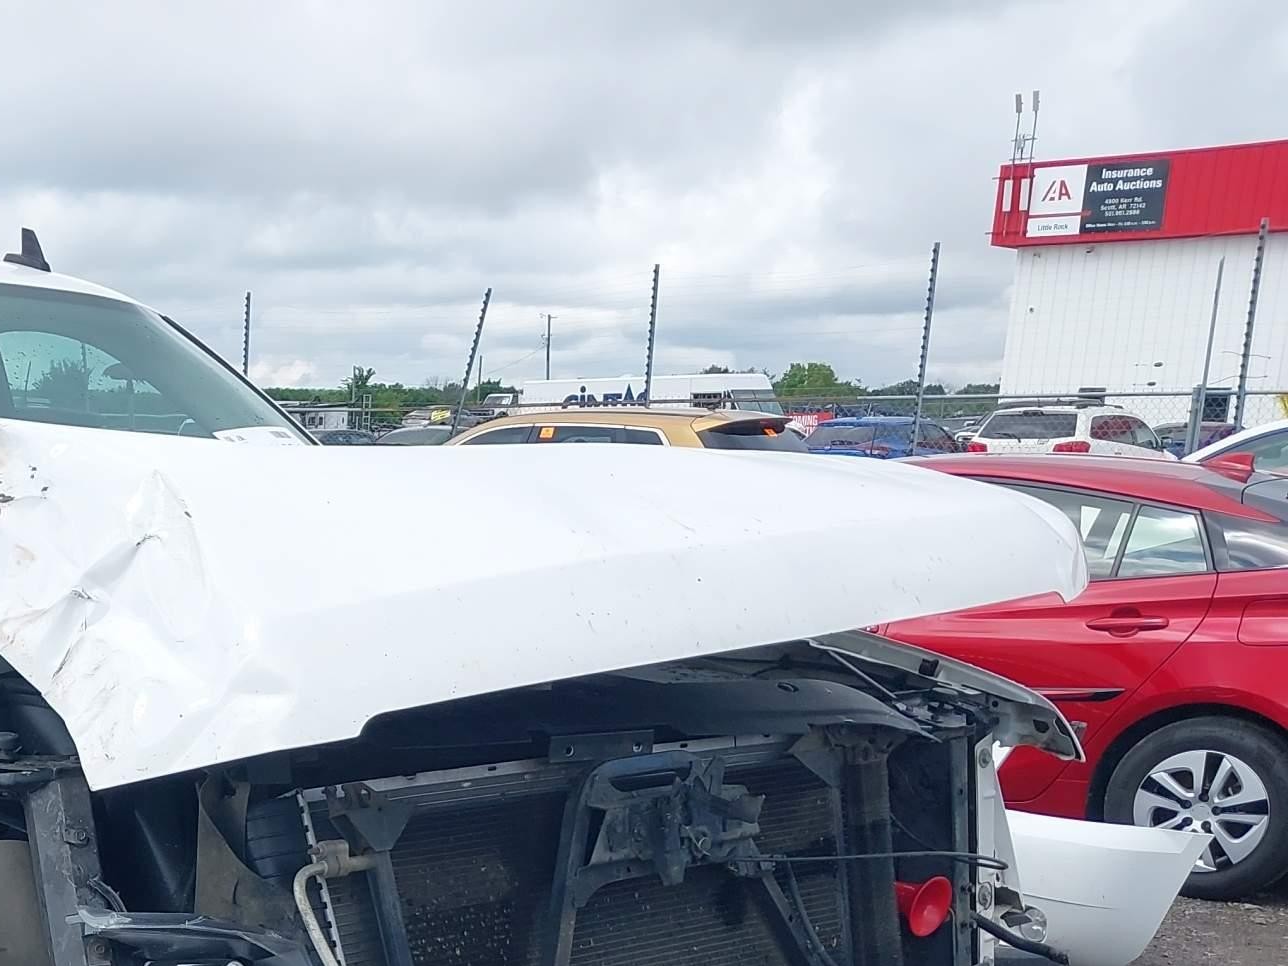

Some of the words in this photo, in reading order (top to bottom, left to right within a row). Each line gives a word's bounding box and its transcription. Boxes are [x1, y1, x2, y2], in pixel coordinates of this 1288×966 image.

[1102, 167, 1153, 179] Insurance
[1090, 181, 1113, 193] Auto
[1115, 179, 1163, 191] Auctions
[1037, 224, 1052, 232] Little
[1053, 223, 1068, 231] Rock
